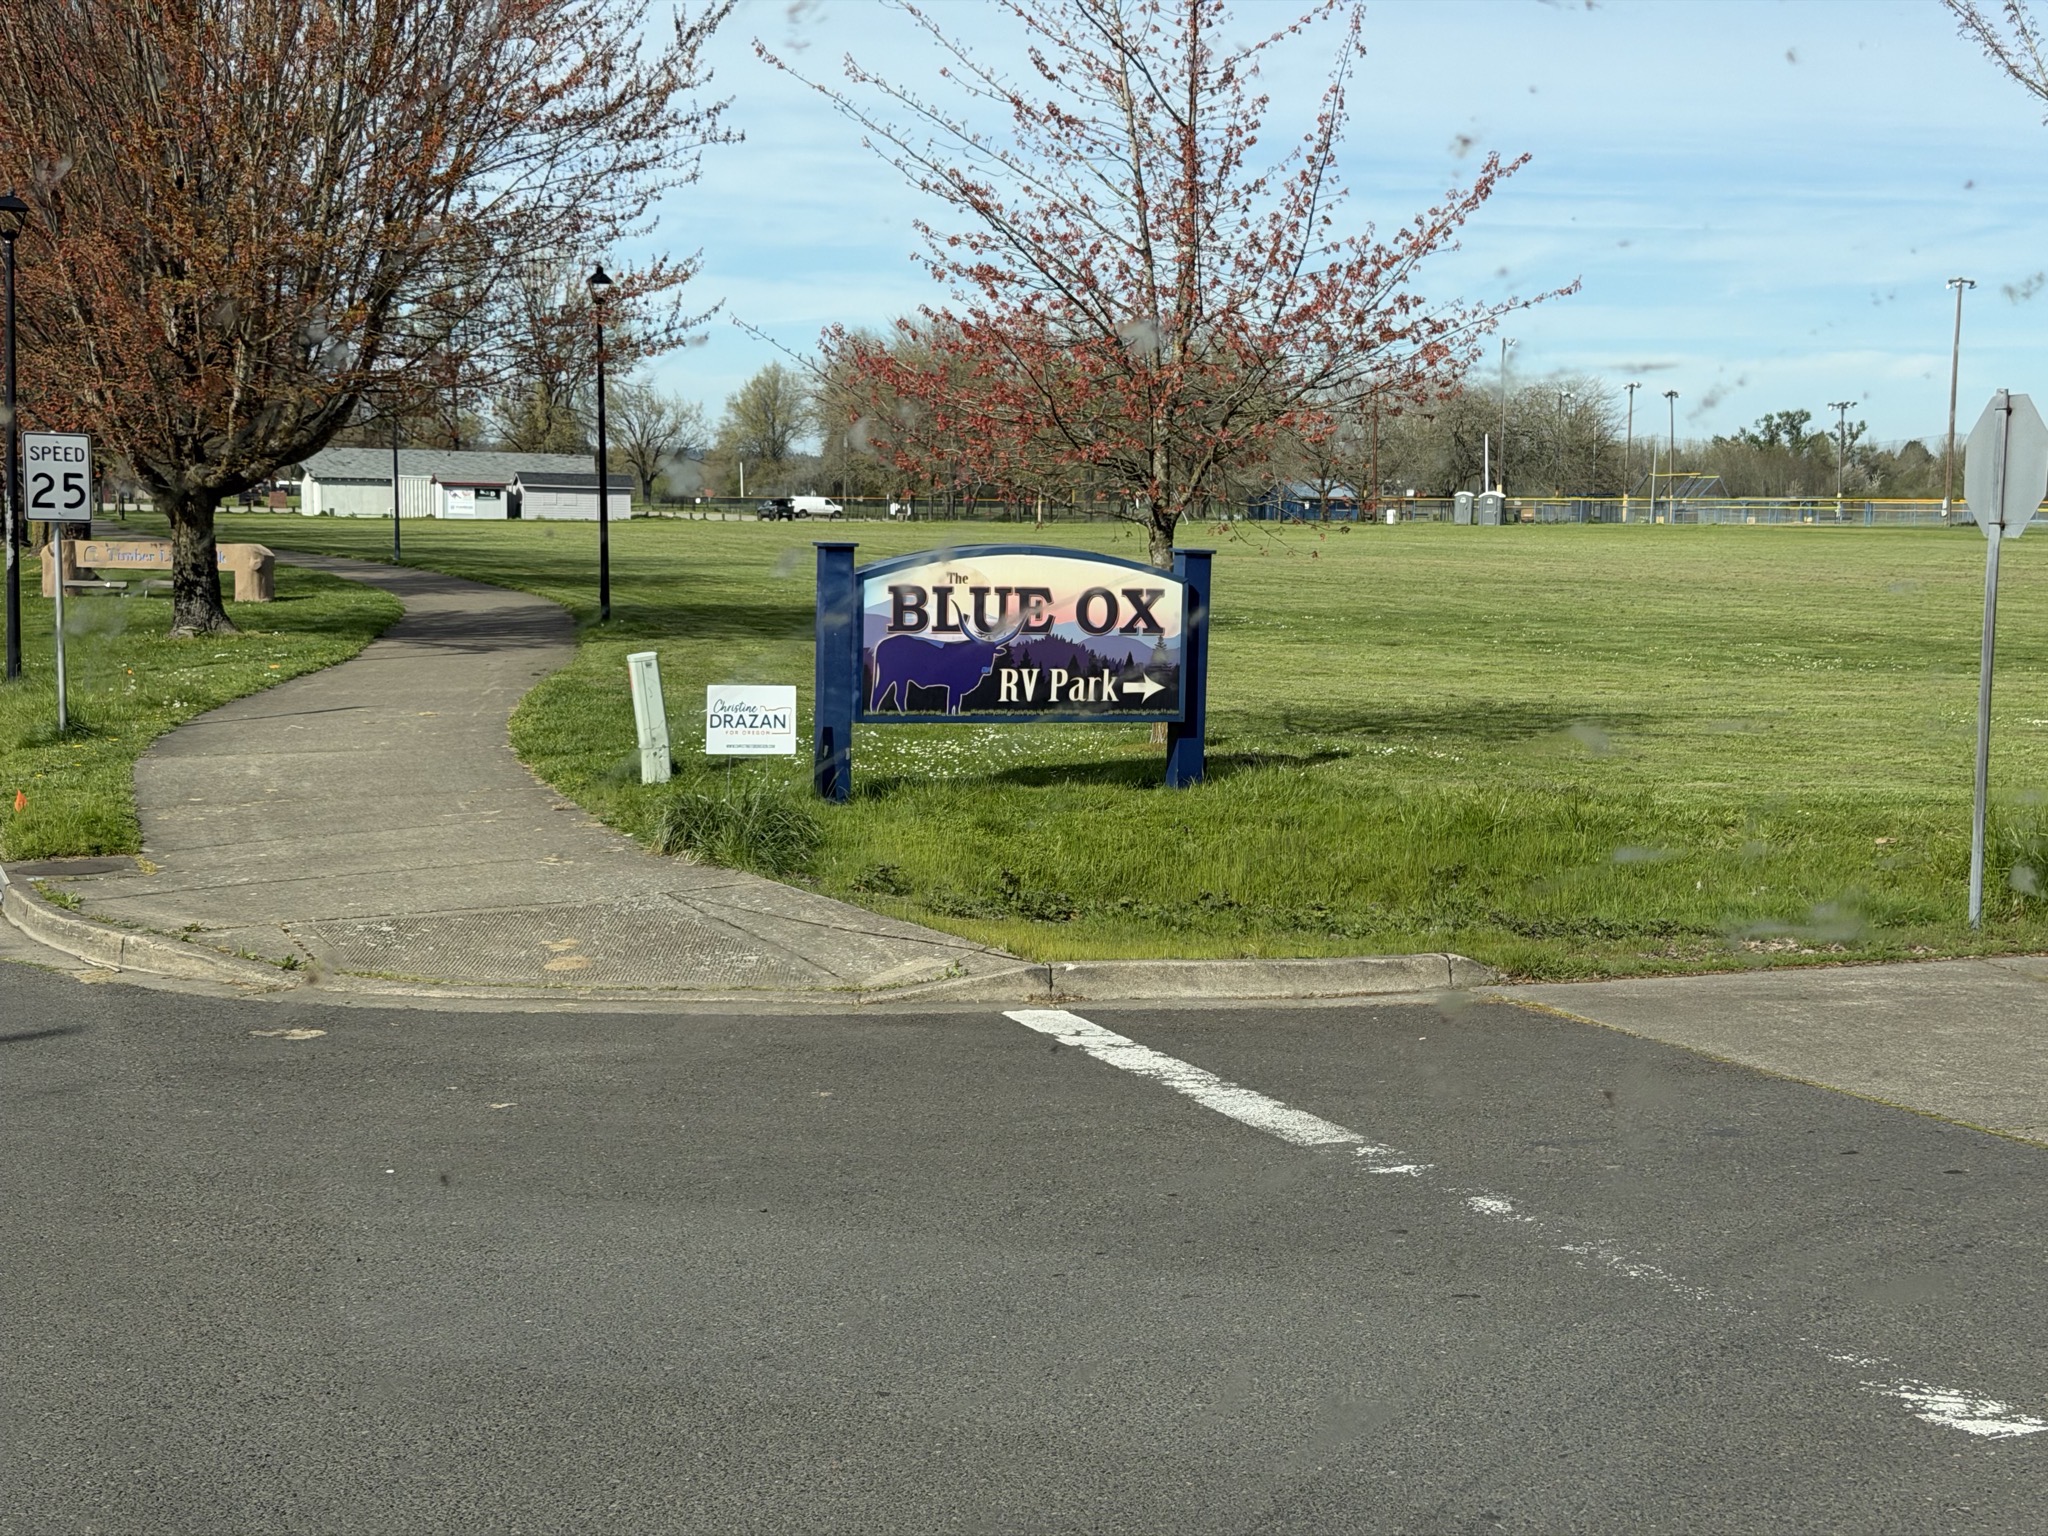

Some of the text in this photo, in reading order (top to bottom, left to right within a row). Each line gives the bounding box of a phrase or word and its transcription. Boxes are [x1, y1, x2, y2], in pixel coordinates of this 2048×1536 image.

[29, 446, 85, 463] SPEED
[31, 472, 86, 509] 25
[107, 547, 155, 562] Timber
[946, 571, 969, 585] The
[887, 585, 1166, 636] BLUE OX
[998, 668, 1119, 703] RV Park
[713, 698, 758, 714] Christine
[709, 713, 786, 729] DRAZAN
